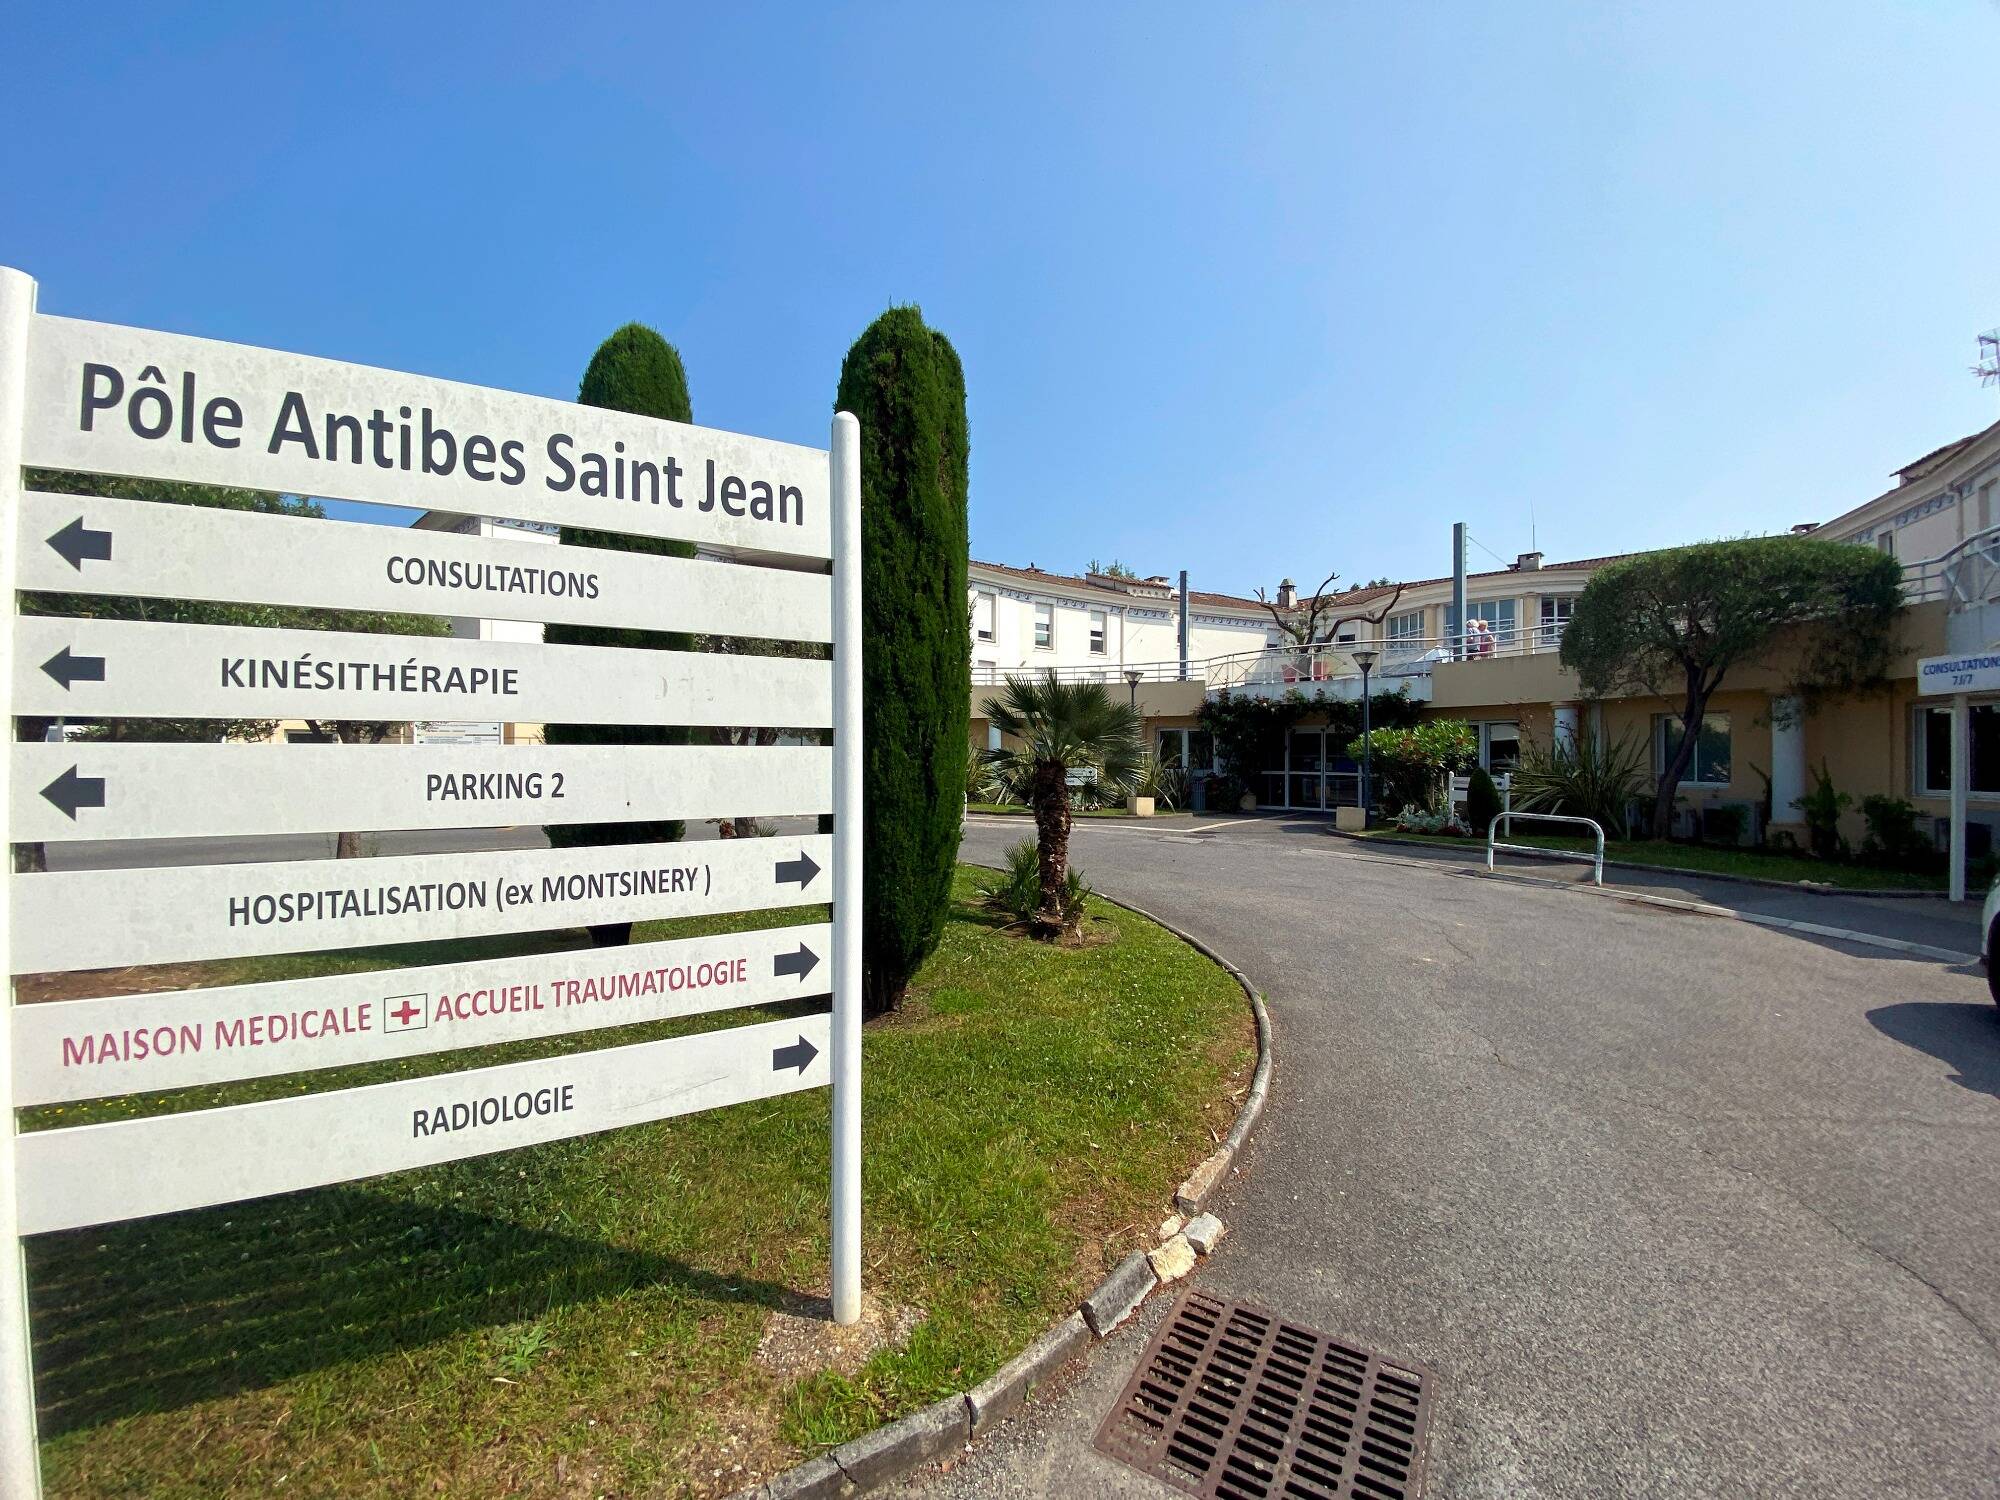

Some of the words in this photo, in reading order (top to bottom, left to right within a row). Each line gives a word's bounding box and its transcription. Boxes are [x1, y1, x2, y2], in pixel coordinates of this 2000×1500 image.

[81, 362, 243, 449] Pôle
[268, 391, 526, 486] Antibes
[545, 433, 683, 509] Saint
[698, 458, 803, 526] Jean
[386, 556, 600, 600] CONSULTATIONS
[221, 652, 518, 695] KINÉSITHÉRAPIE
[427, 772, 542, 801] PARKING
[551, 772, 565, 798] 2
[229, 880, 487, 927] HOSPITALISATION
[496, 877, 534, 913] (ex
[62, 1023, 202, 1067] MAISON
[215, 1003, 373, 1050] MEDICALE
[434, 984, 545, 1023] ACCUEIL
[550, 958, 748, 1009] TRAUMATOLOGIE
[413, 1084, 575, 1138] RADIOLOGIE
